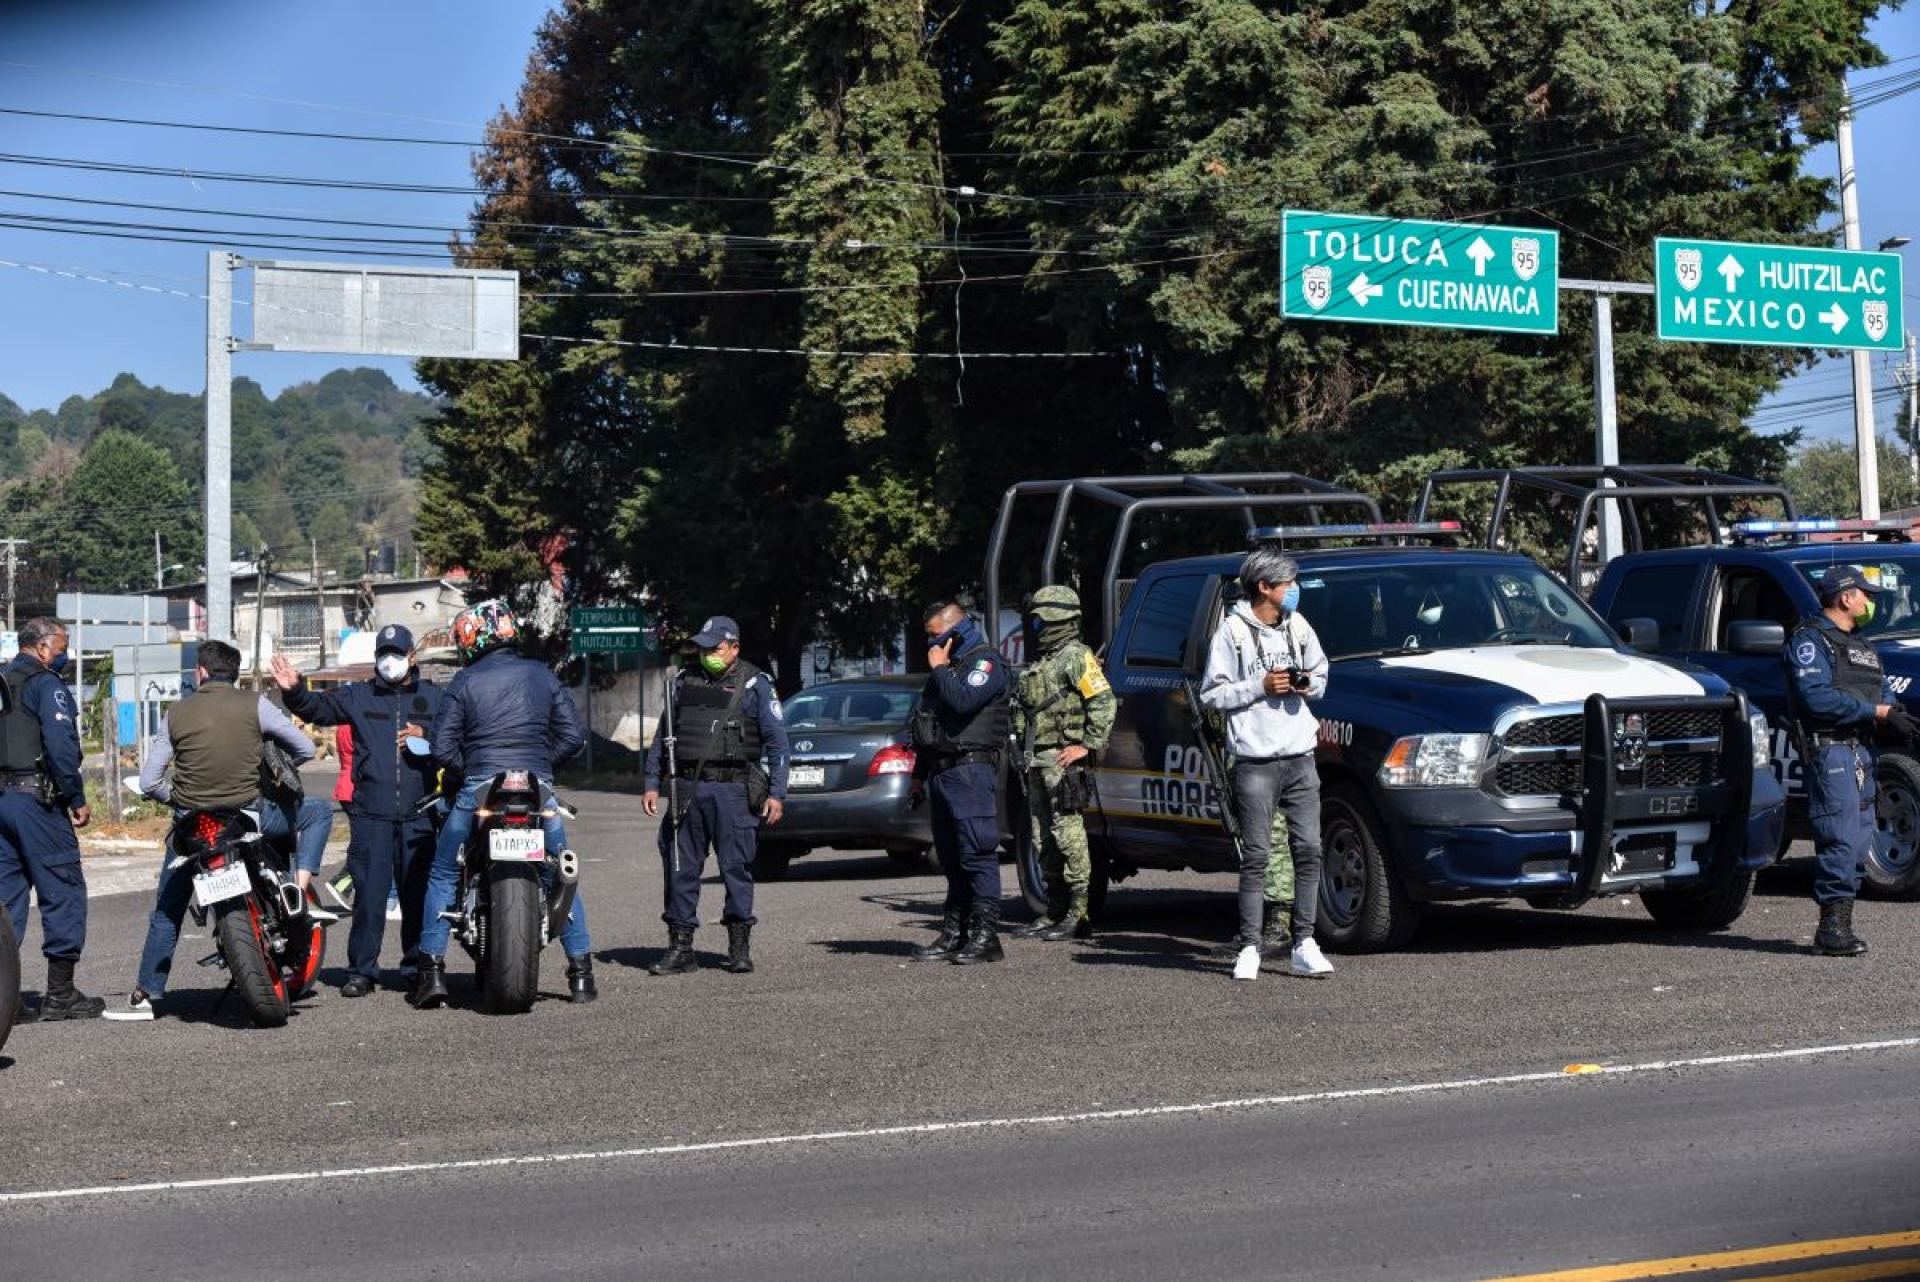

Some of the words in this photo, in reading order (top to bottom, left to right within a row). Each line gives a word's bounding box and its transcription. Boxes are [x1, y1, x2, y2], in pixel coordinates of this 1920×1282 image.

[1303, 230, 1449, 267] TOLUCA
[1516, 252, 1534, 270] 95
[1679, 263, 1697, 281] 95
[1759, 260, 1886, 294] HUITZILAC
[1308, 280, 1326, 298] 95
[1397, 278, 1540, 315] CUERNAVACA
[1674, 296, 1806, 330] MEXICO
[1867, 313, 1884, 331] 95
[580, 635, 627, 649] HUITZILAC
